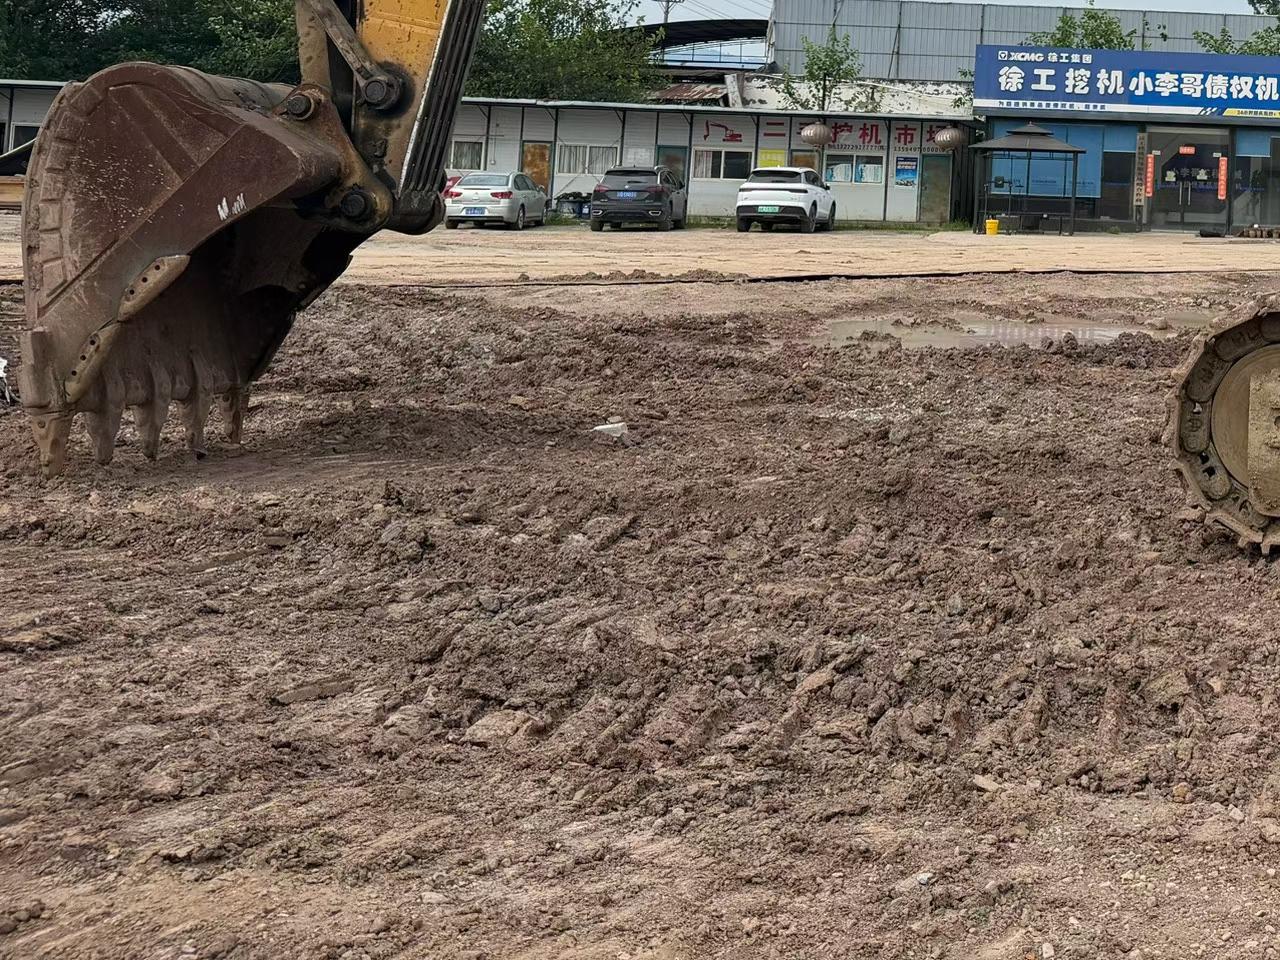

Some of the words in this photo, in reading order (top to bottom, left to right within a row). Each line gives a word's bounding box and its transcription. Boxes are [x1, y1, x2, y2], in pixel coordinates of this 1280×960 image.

[1009, 52, 1044, 62] XCMG
[1047, 52, 1092, 64] 徐工集团
[764, 122, 939, 146] 二挖机市
